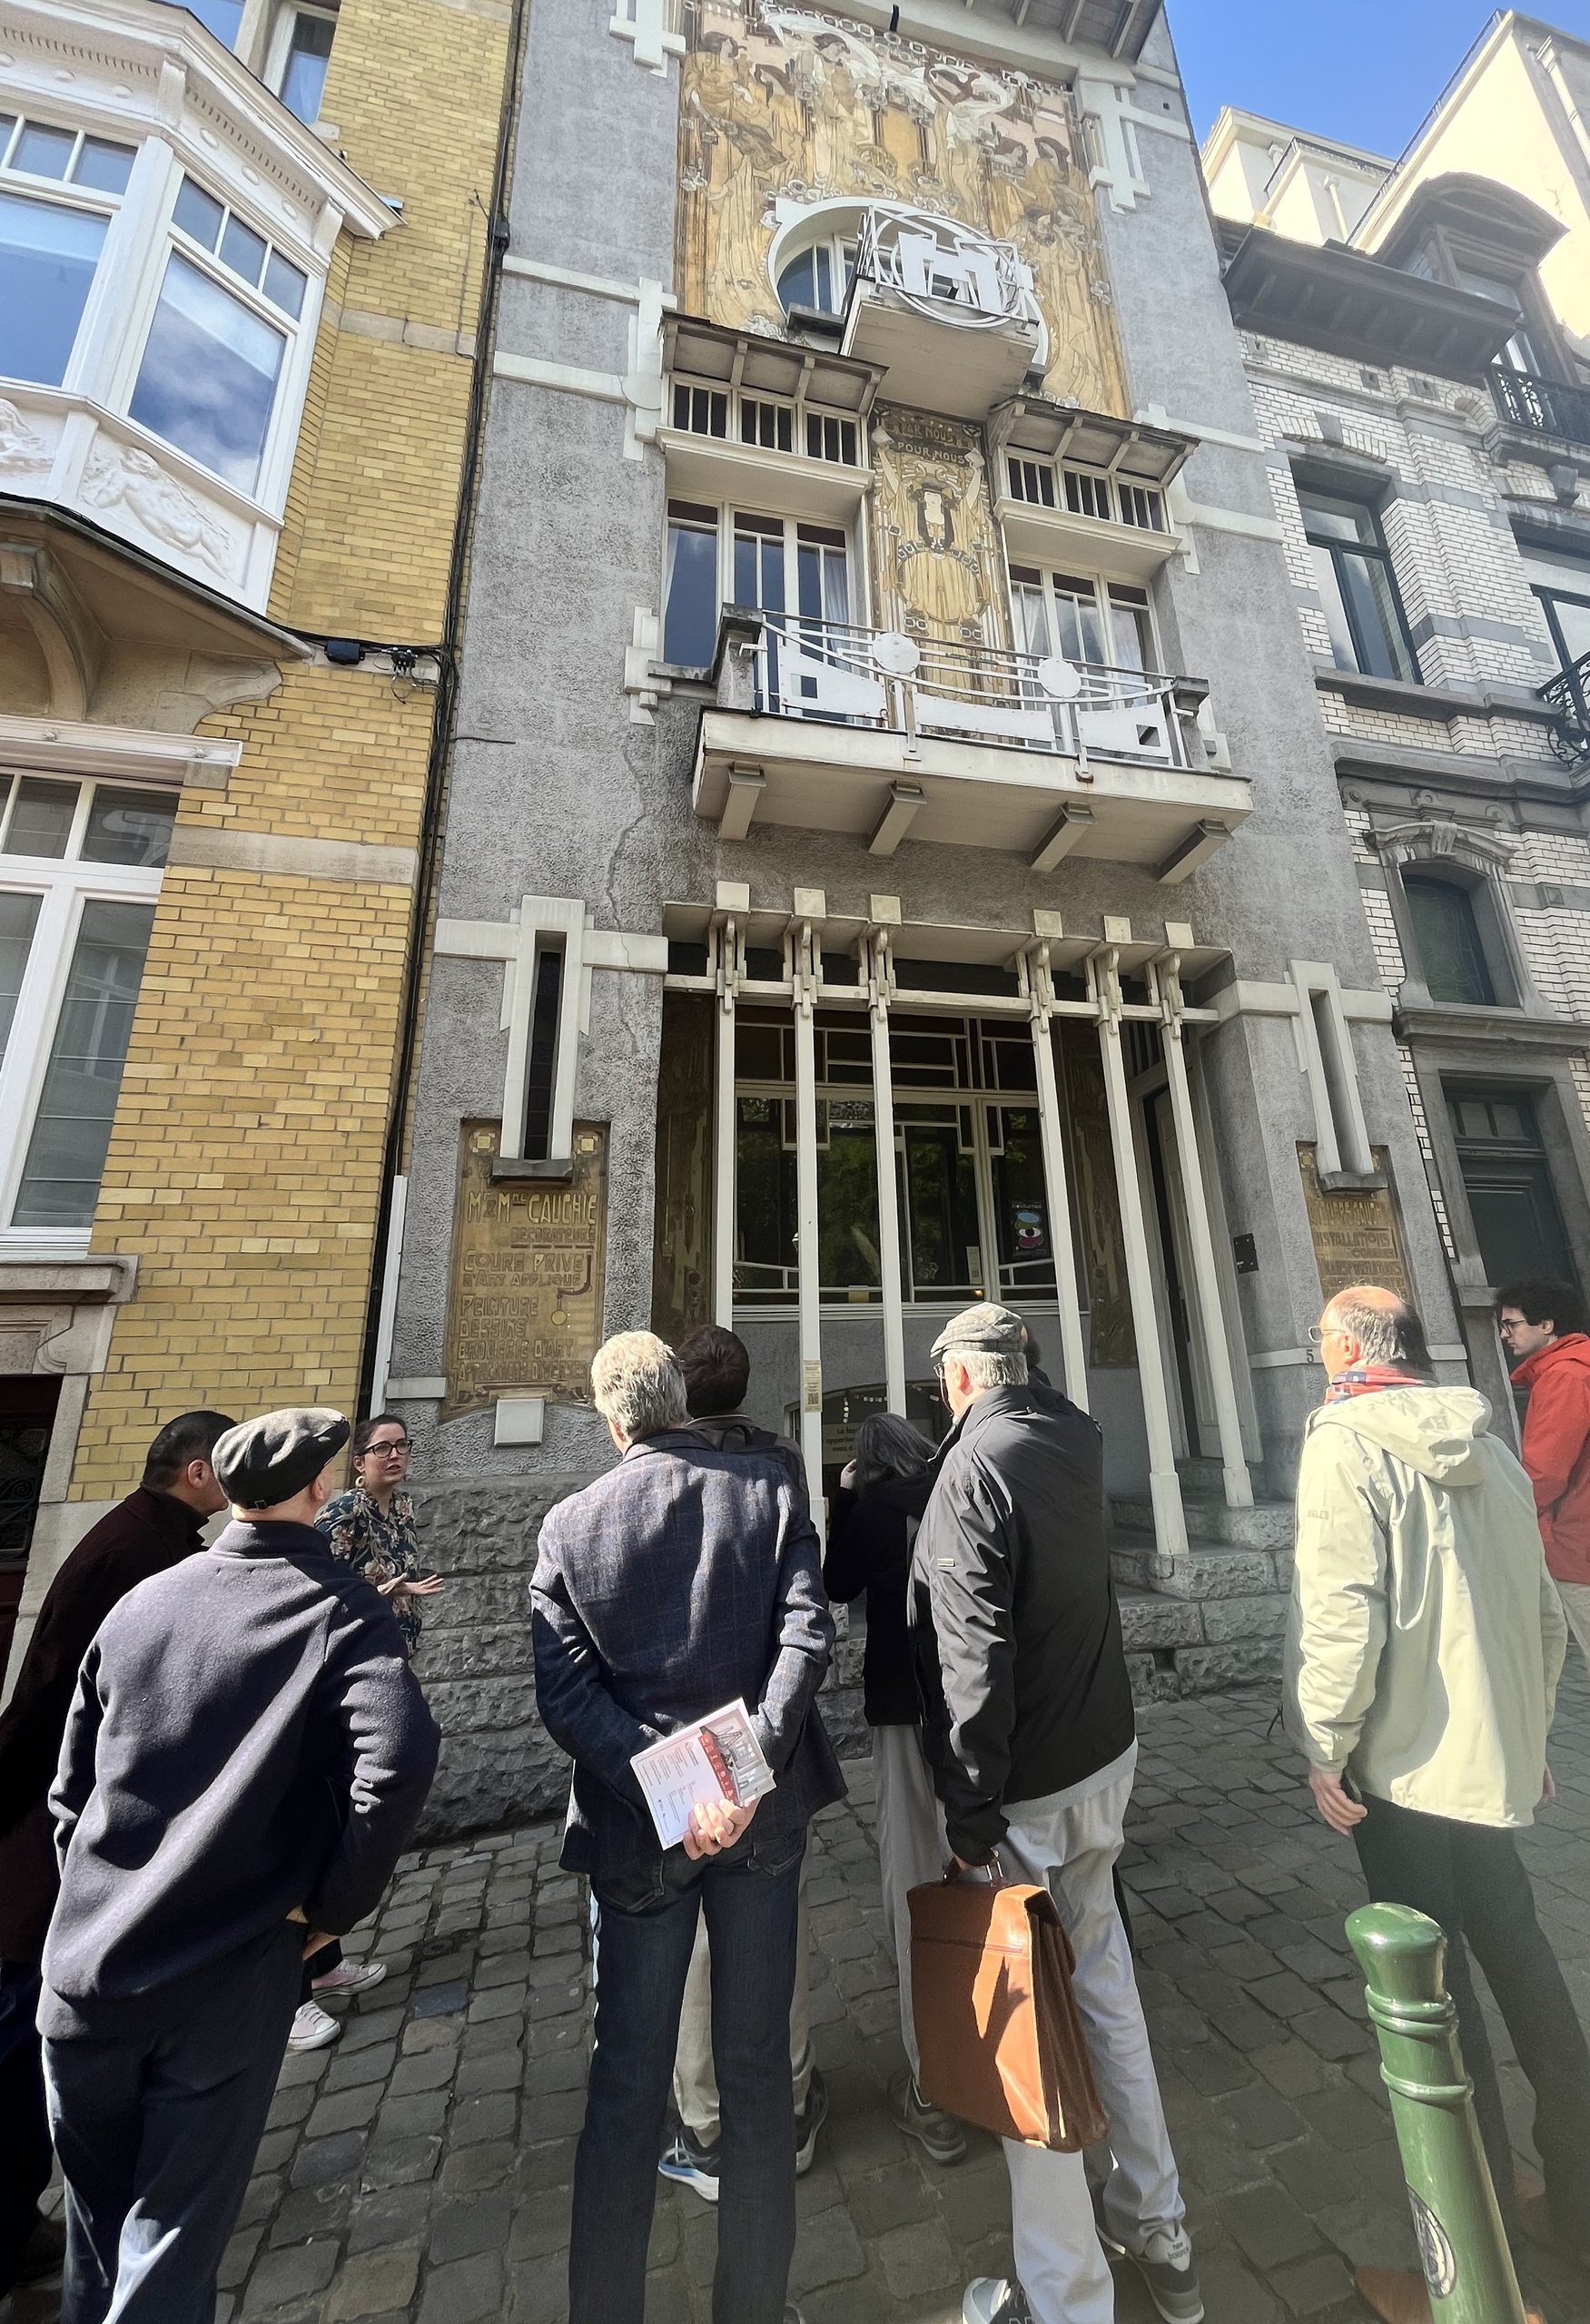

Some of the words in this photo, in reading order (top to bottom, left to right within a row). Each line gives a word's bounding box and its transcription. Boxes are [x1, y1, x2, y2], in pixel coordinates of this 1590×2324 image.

[925, 426, 953, 442] NOUS
[897, 441, 932, 458] POUR
[934, 449, 965, 464] NOUS
[528, 1191, 598, 1225] CAUCHIE
[463, 1248, 525, 1272] COURS
[460, 1294, 539, 1316] PEINTURE
[459, 1318, 527, 1338] DESSINS
[458, 1339, 529, 1360] BRODERIE
[1306, 1348, 1315, 1364] 5
